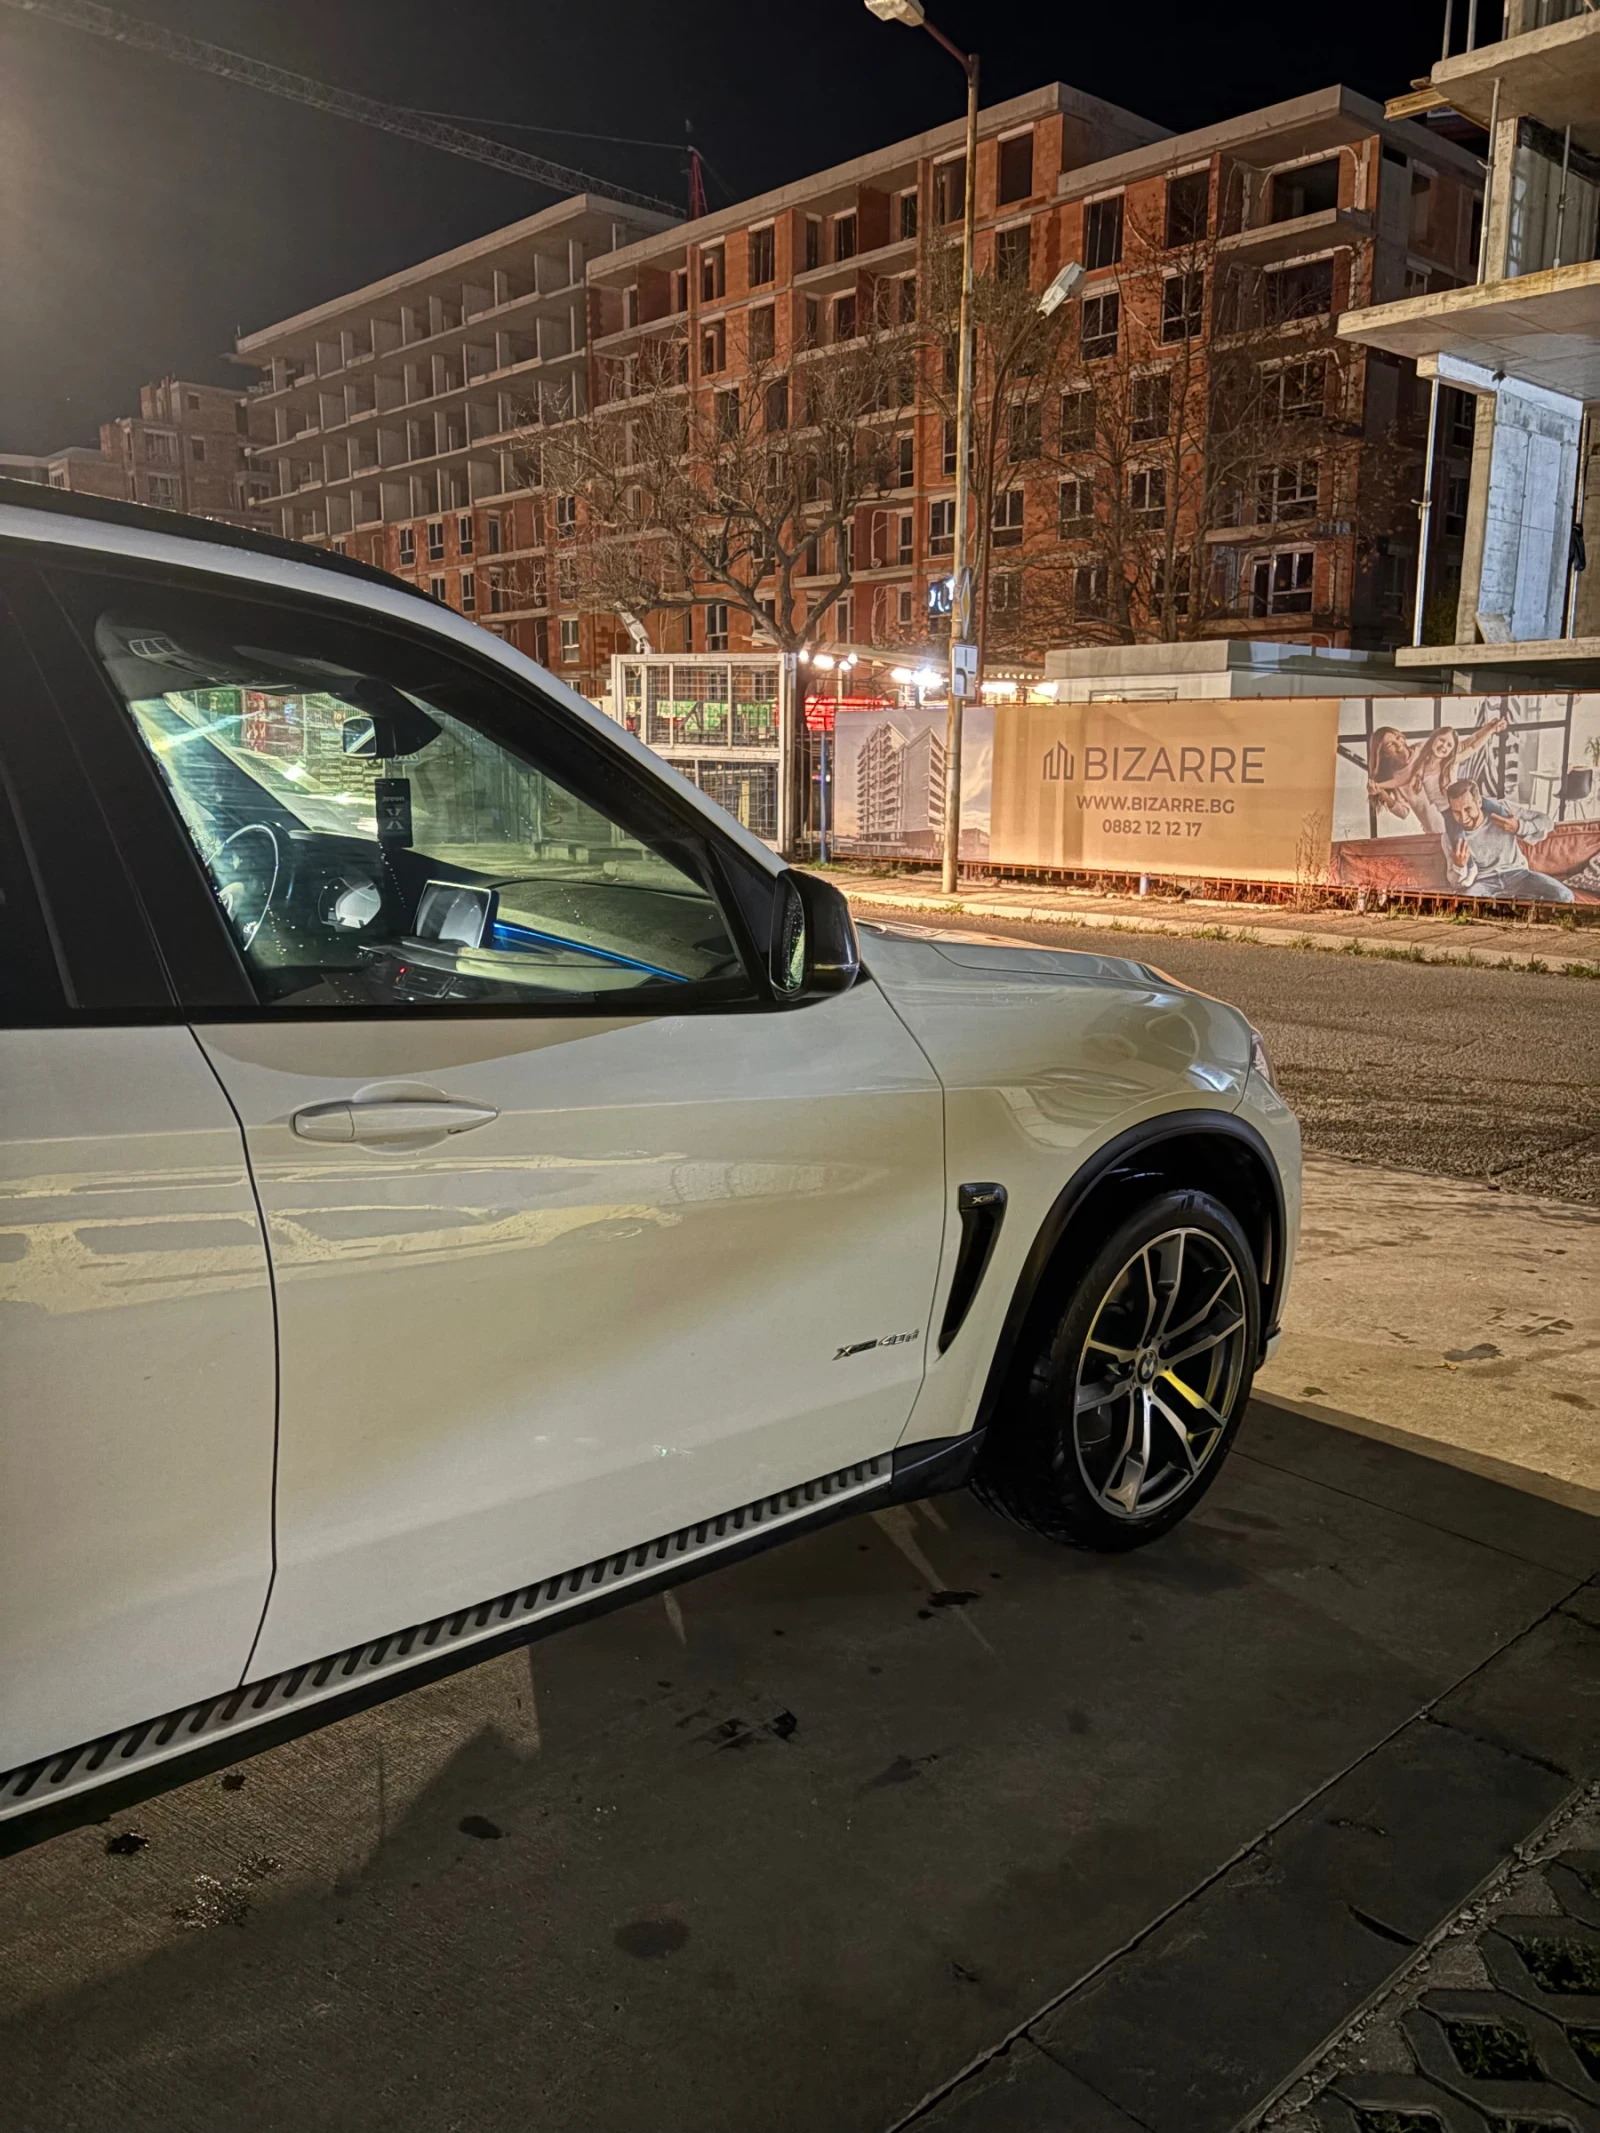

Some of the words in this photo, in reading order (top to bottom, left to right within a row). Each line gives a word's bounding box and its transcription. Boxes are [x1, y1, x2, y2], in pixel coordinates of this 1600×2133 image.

[1084, 746, 1266, 784] BIZARRE
[1076, 794, 1235, 814] WWW.BIZARRE.BG
[1102, 818, 1141, 834] 0882
[1145, 820, 1161, 835] 12
[1165, 821, 1181, 836] 12
[1185, 822, 1202, 837] 17
